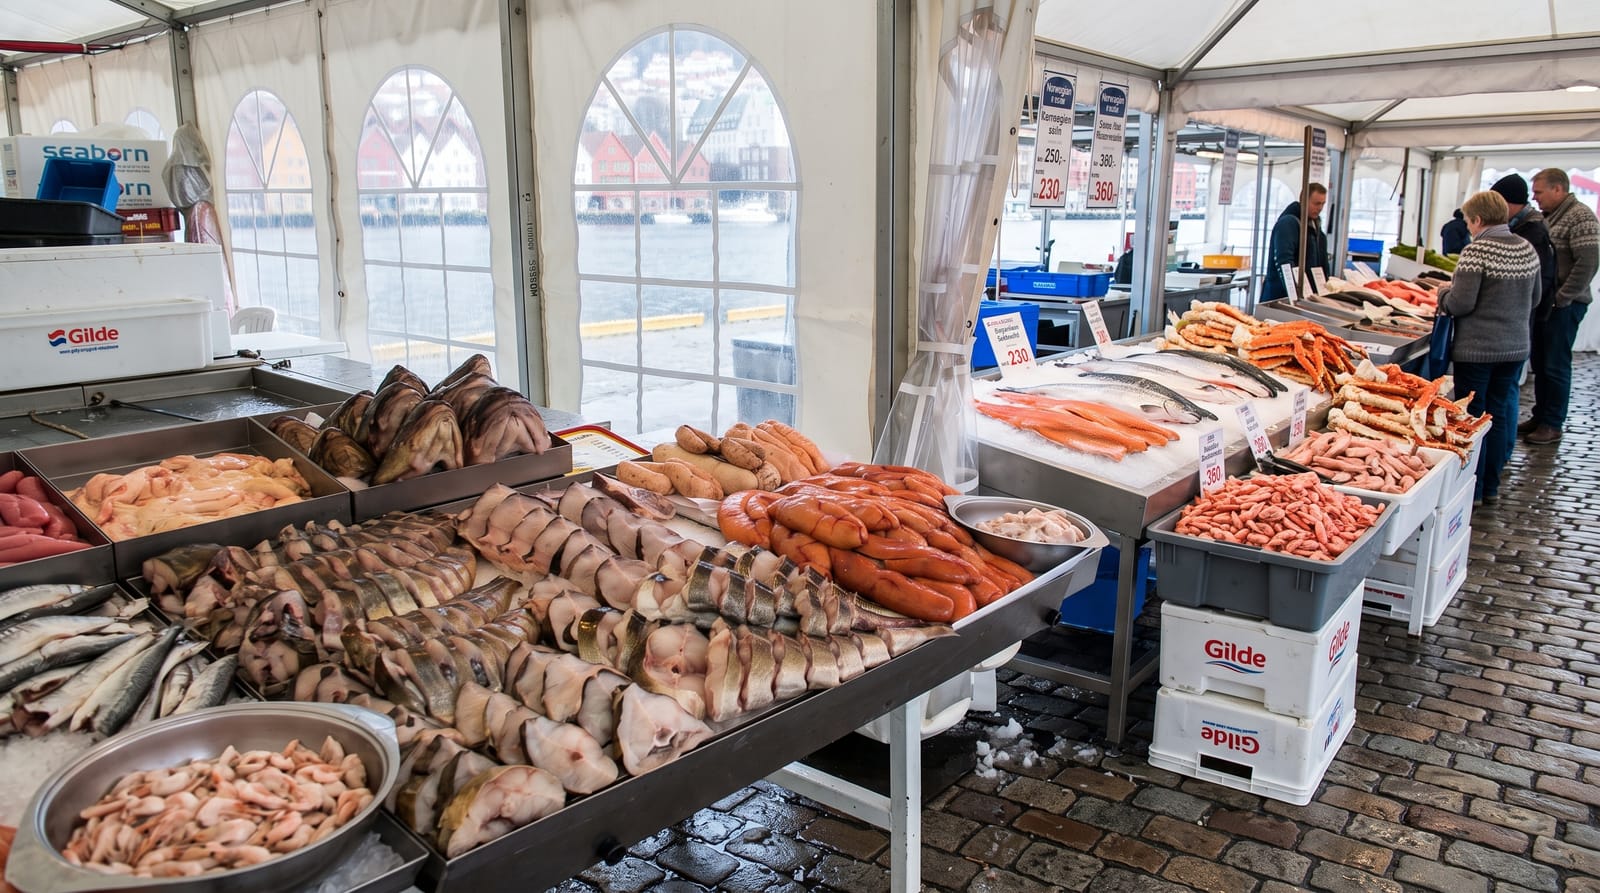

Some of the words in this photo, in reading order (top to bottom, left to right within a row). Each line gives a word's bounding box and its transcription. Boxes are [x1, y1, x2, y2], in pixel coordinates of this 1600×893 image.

[42, 144, 149, 161] seaborn
[68, 326, 119, 344] Gilde
[1204, 639, 1266, 668] Gilde
[1329, 621, 1350, 662] Gilde
[1201, 726, 1260, 755] Gilde
